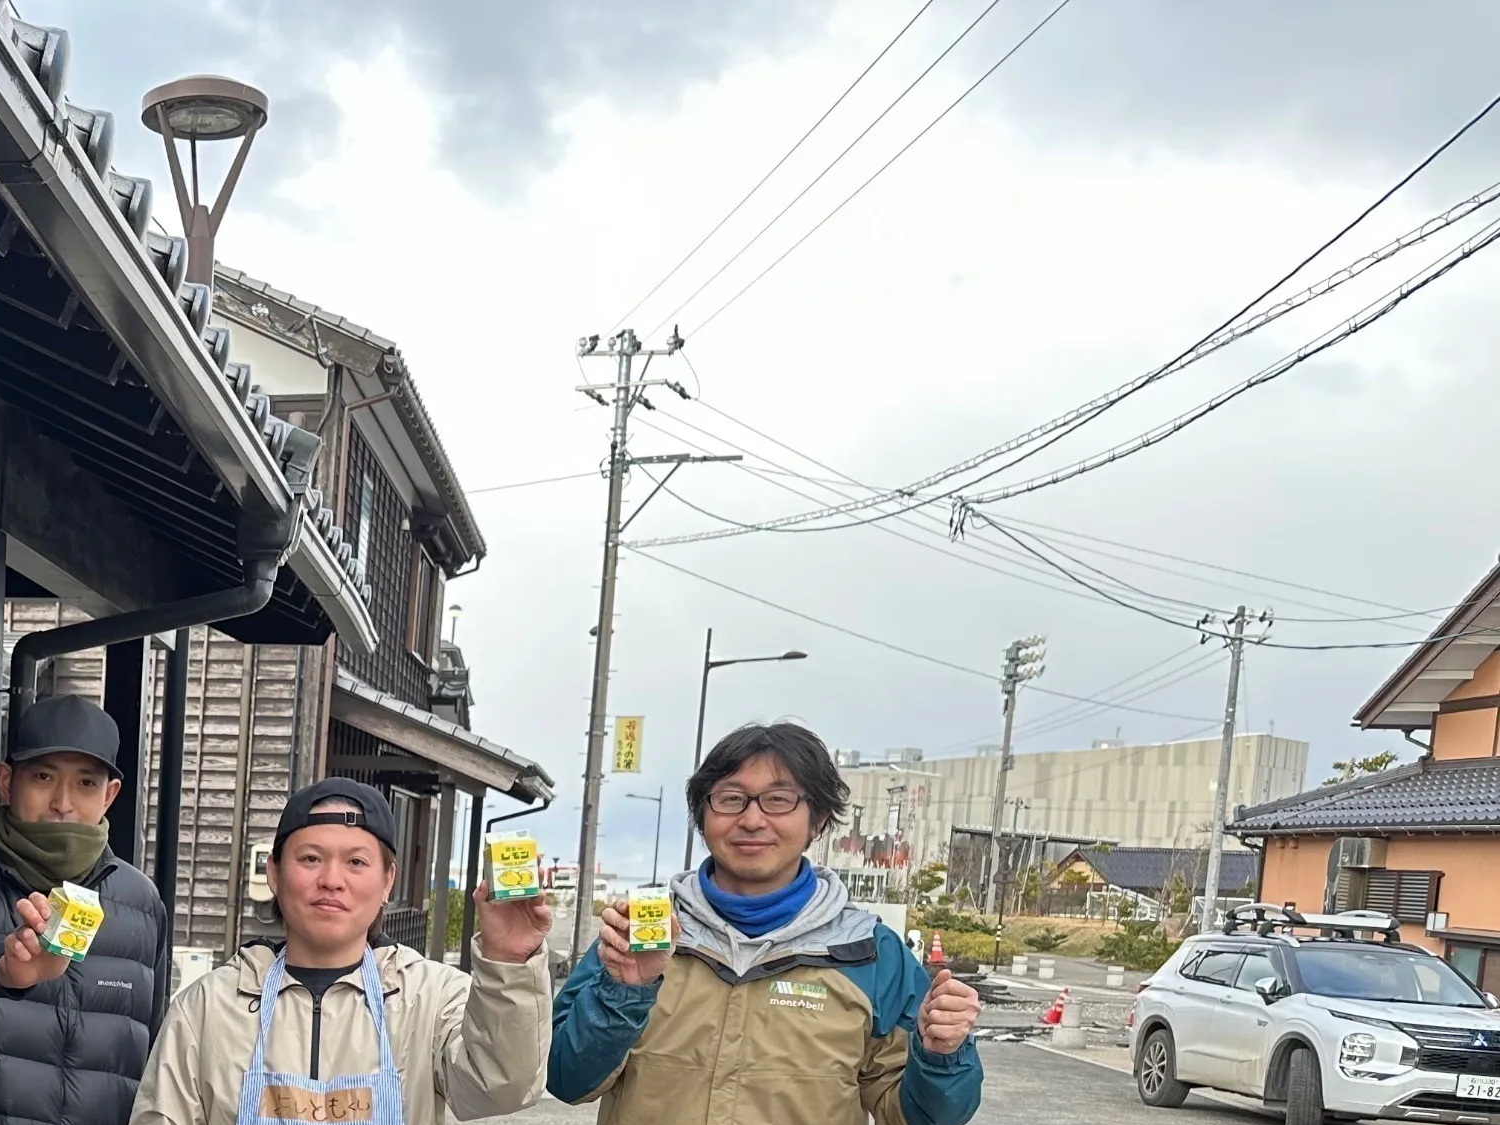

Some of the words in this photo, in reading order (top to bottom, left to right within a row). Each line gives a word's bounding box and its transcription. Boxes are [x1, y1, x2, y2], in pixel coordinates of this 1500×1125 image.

[501, 851, 529, 860] レモン
[637, 910, 663, 918] レモン
[71, 913, 95, 927] レモン
